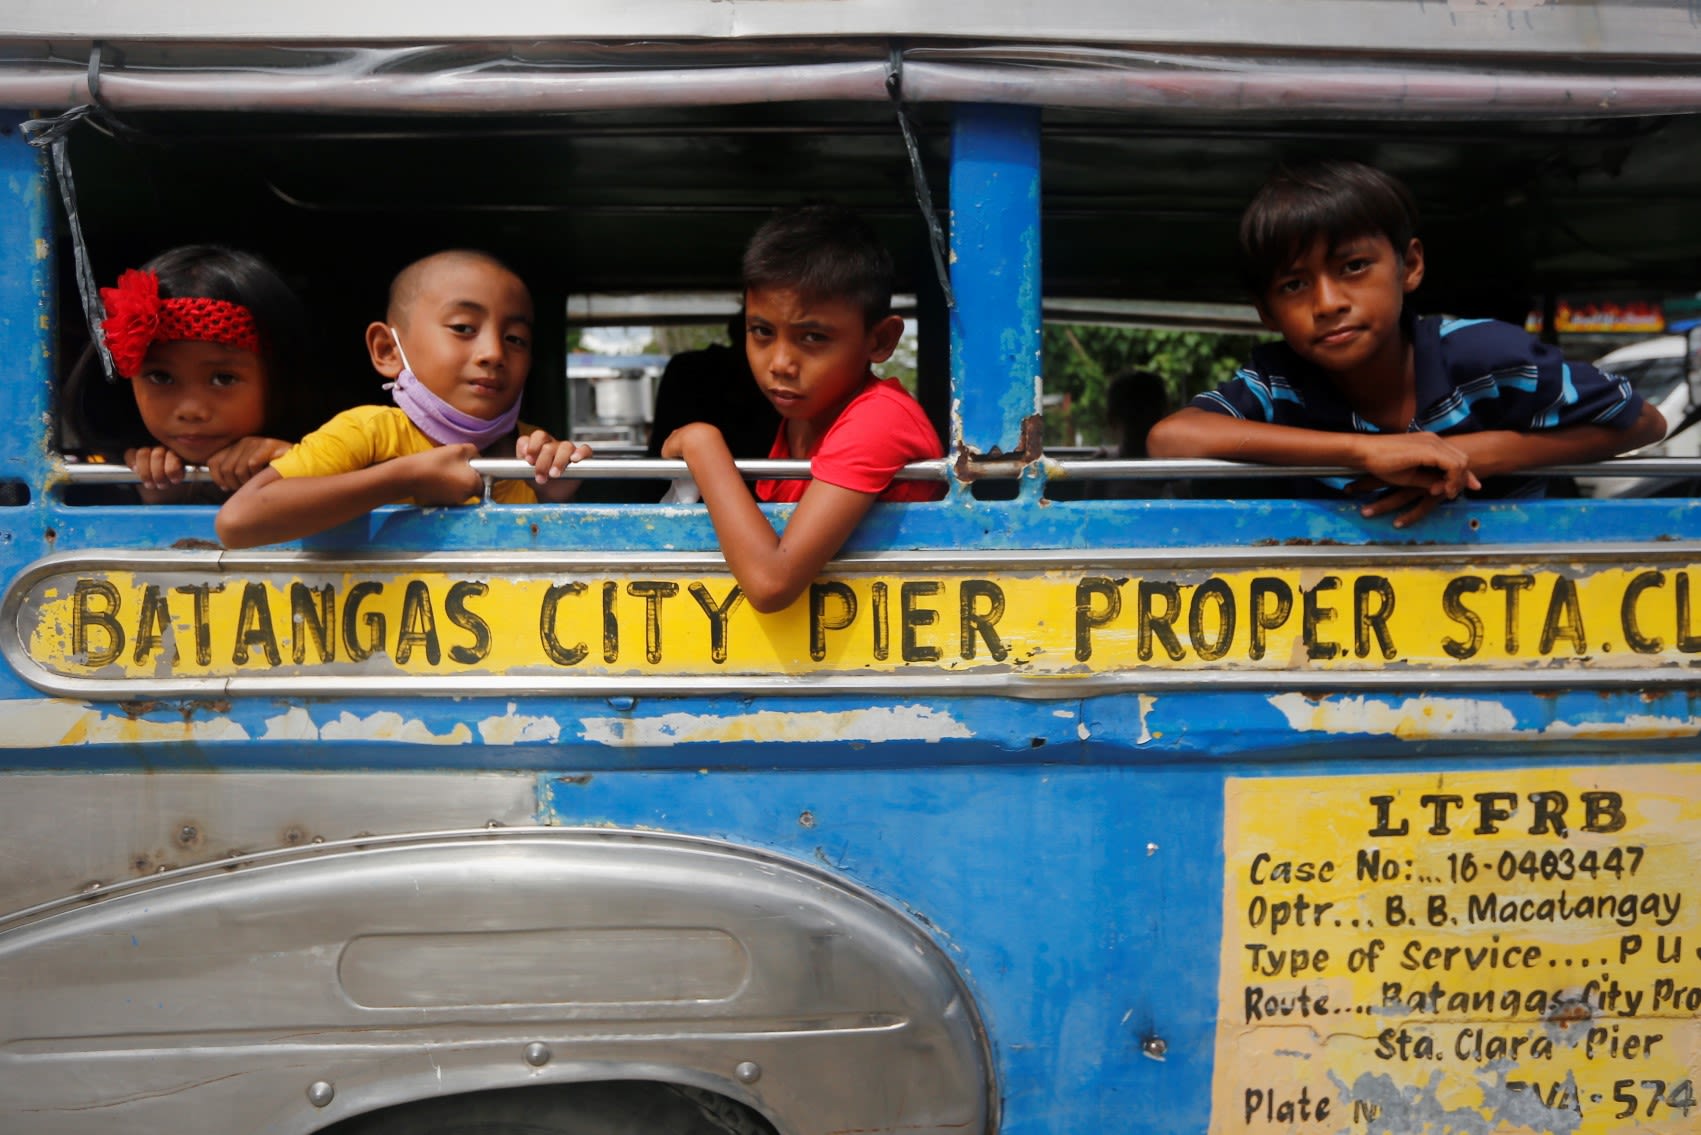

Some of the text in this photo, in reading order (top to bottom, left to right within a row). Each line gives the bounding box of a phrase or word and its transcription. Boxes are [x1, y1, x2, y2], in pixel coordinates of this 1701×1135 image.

[72, 579, 492, 666] BATANGAS
[540, 580, 747, 665] CITY
[808, 580, 1009, 662] PIER
[1075, 575, 1398, 661] PROPER
[1368, 790, 1627, 838] LTFRB
[1250, 852, 1336, 885] Case
[1468, 889, 1682, 927] Macatangay
[1244, 943, 1330, 978] Type
[1347, 939, 1386, 973] of
[1653, 978, 1701, 1012] Pro
[1374, 1028, 1443, 1062] Sta.
[1586, 1025, 1664, 1061] Pier
[1244, 1087, 1331, 1125] Plate
